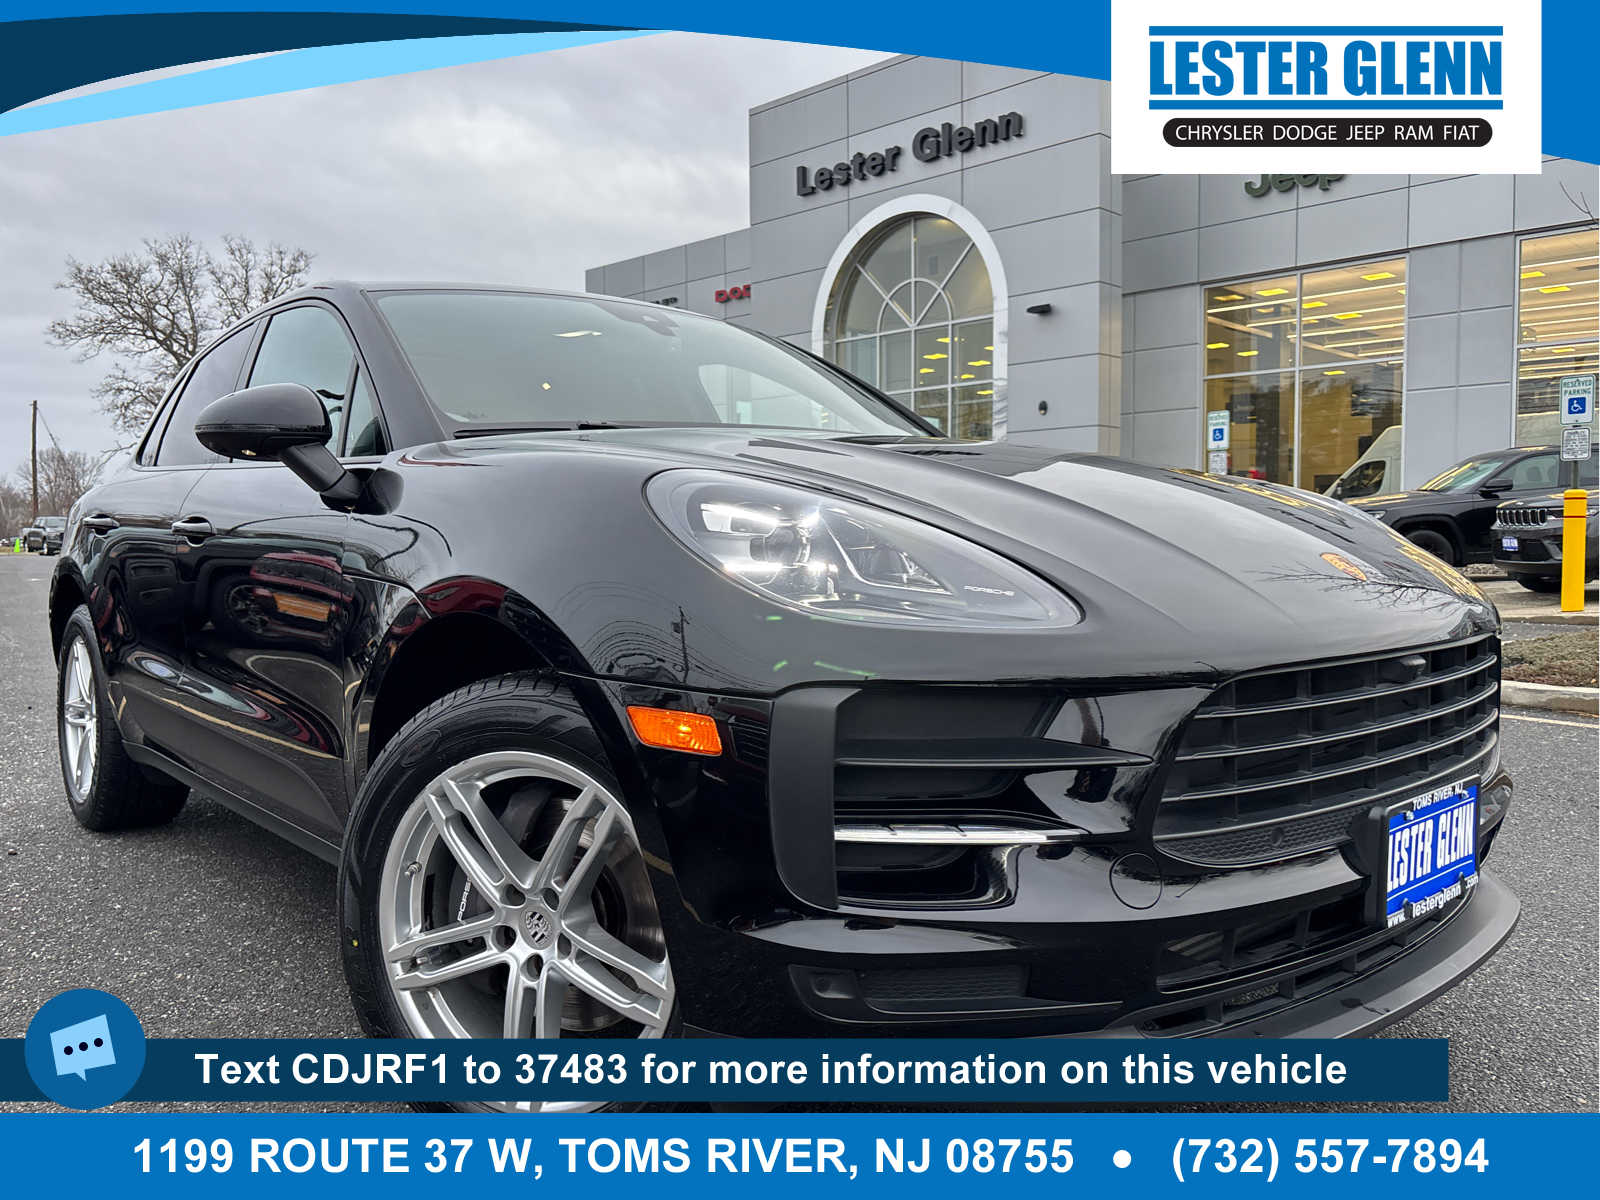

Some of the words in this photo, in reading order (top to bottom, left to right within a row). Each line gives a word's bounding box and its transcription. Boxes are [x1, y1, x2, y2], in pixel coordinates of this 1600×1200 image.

[796, 144, 902, 197] Lester
[911, 110, 1025, 163] Glenn
[1412, 794, 1432, 811] TOMS
[1387, 819, 1434, 892] LESTER
[1437, 802, 1475, 870] GLENN
[1412, 881, 1462, 918] lesterglenn
